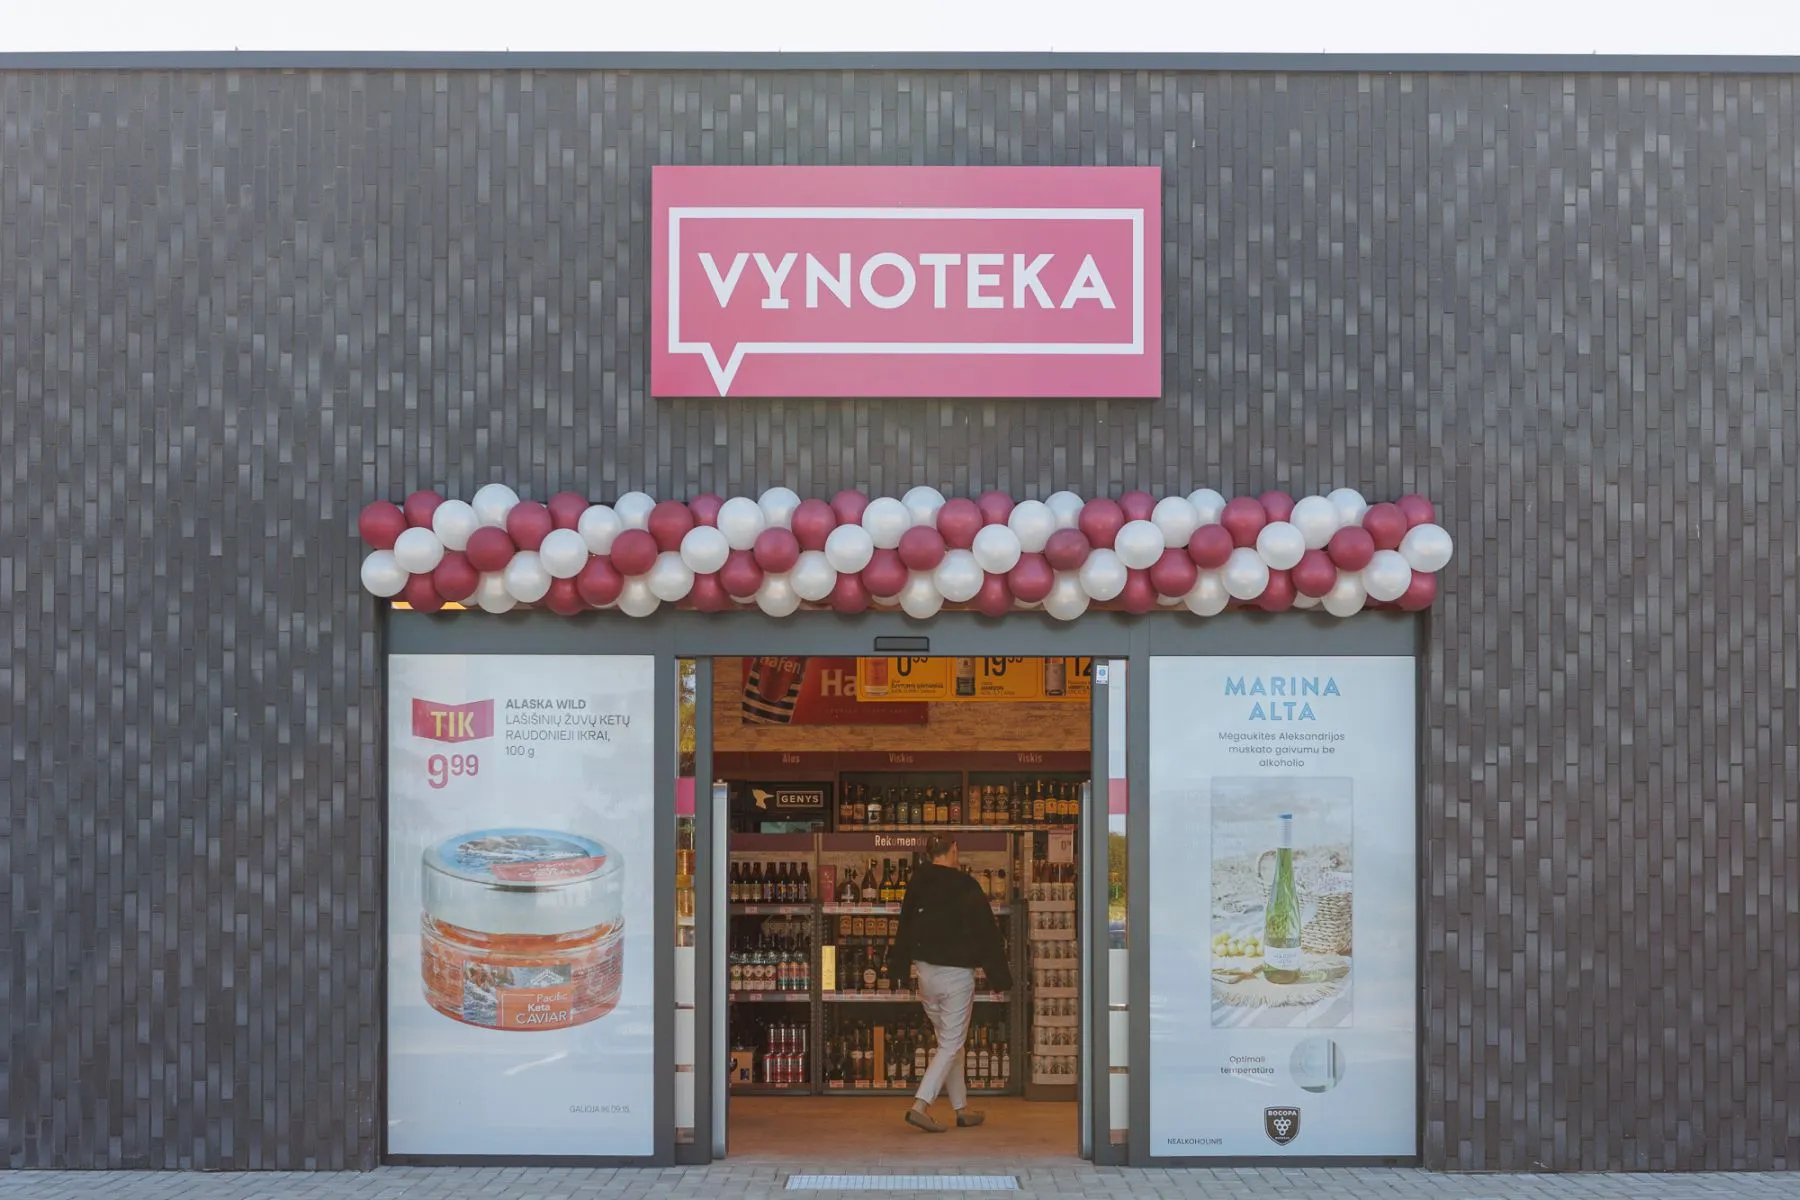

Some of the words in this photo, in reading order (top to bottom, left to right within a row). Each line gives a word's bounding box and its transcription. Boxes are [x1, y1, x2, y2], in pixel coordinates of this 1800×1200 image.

[698, 252, 1117, 309] VYNOTEKA
[1224, 676, 1341, 697] MARINA
[505, 699, 553, 709] ALASKA
[556, 699, 586, 709] WILD
[1248, 701, 1316, 721] ALTA
[430, 711, 475, 737] TIK
[505, 713, 561, 727] LAŠIŠINIŲ
[564, 713, 597, 727] ŽUVŲ
[600, 715, 630, 727] KETŲ
[505, 730, 574, 741] RAUDONIEJI
[577, 730, 610, 742] IKRAI,
[1278, 732, 1345, 743] Aleksandrijos
[505, 745, 525, 756] 100
[527, 747, 535, 758] g
[1228, 745, 1273, 754] muskato
[1275, 746, 1319, 756] gaivumu
[1322, 746, 1335, 754] be
[888, 752, 914, 763] Viskis
[1017, 752, 1043, 763] Viskis
[1258, 758, 1305, 767] alkoholio
[781, 794, 819, 803] GENYS
[536, 991, 568, 1003] Pacific
[527, 1003, 551, 1012] Keta
[516, 1010, 568, 1025] CAVIAR
[1167, 1138, 1223, 1146] NEALKOHOLINIS
